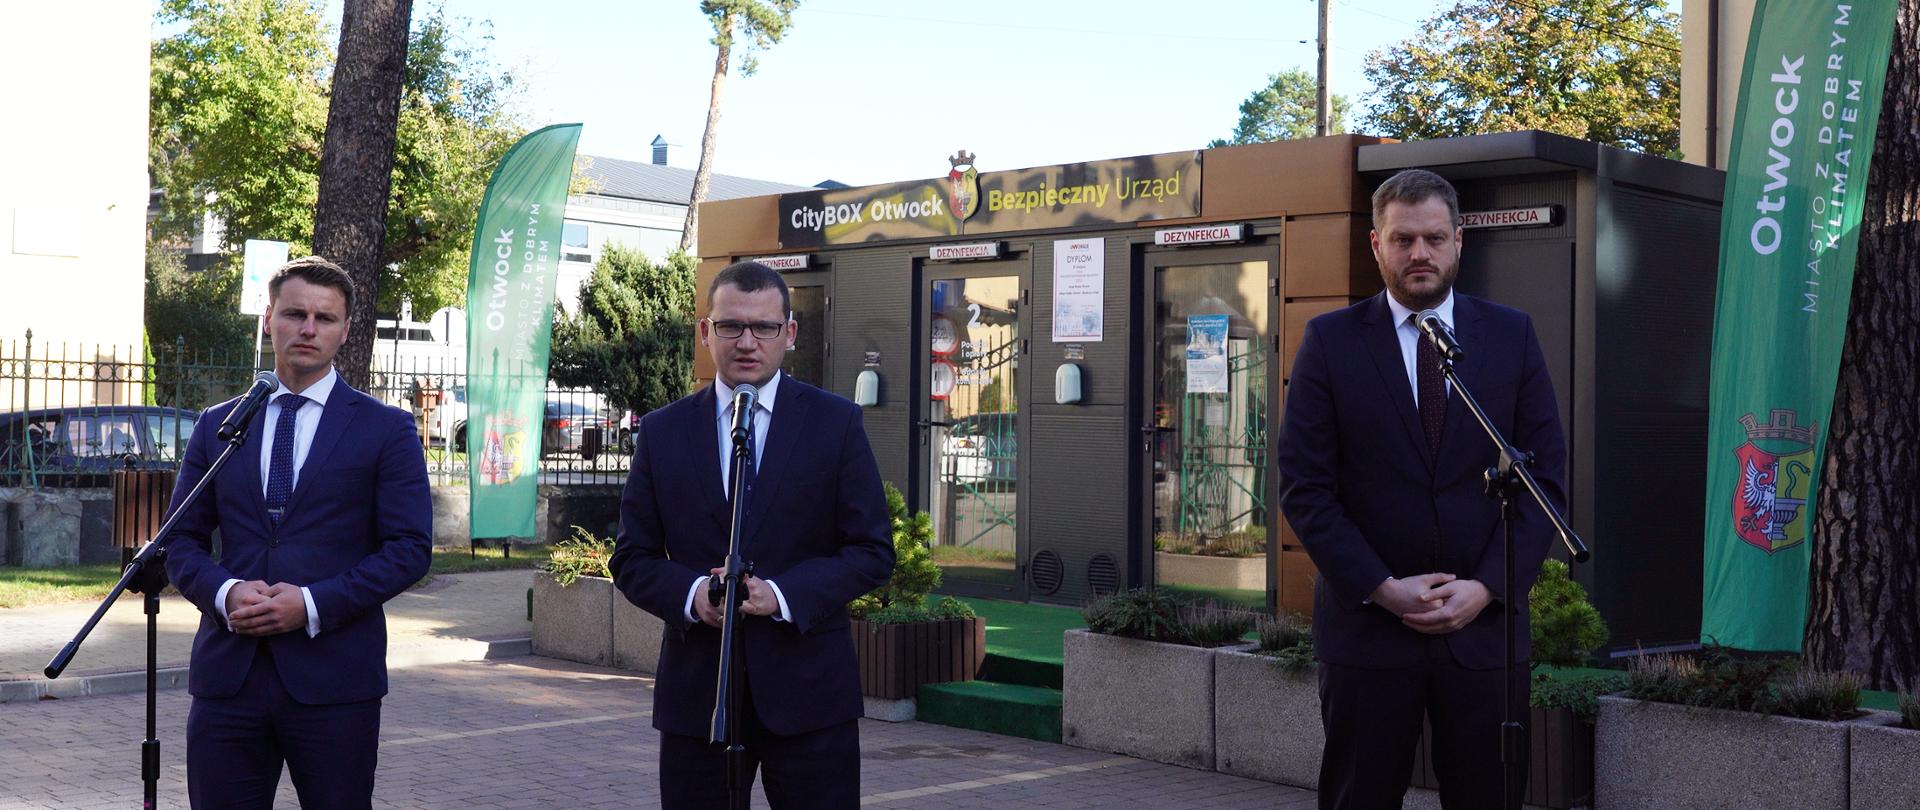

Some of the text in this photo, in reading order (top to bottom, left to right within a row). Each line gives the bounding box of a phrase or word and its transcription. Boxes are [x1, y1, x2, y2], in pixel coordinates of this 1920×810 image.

[1750, 54, 1806, 255] Otwock
[1801, 4, 1852, 313] MIASTO Z DOBRYM
[1826, 79, 1862, 249] KLIMATEM
[791, 170, 1180, 231] CityBOX Otwock Bezpieczny Urząd
[1163, 228, 1230, 243] DEZYNFEKCJA
[1458, 210, 1539, 226] DEZYNFEKCJA
[486, 228, 514, 331] Otwock
[514, 203, 541, 360] MIASTO Z DOBRYM
[531, 240, 549, 326] KLIMATEM
[937, 246, 989, 257] DEZYNFEKCJA
[1067, 254, 1092, 263] DYPLOM
[967, 303, 981, 328] 2
